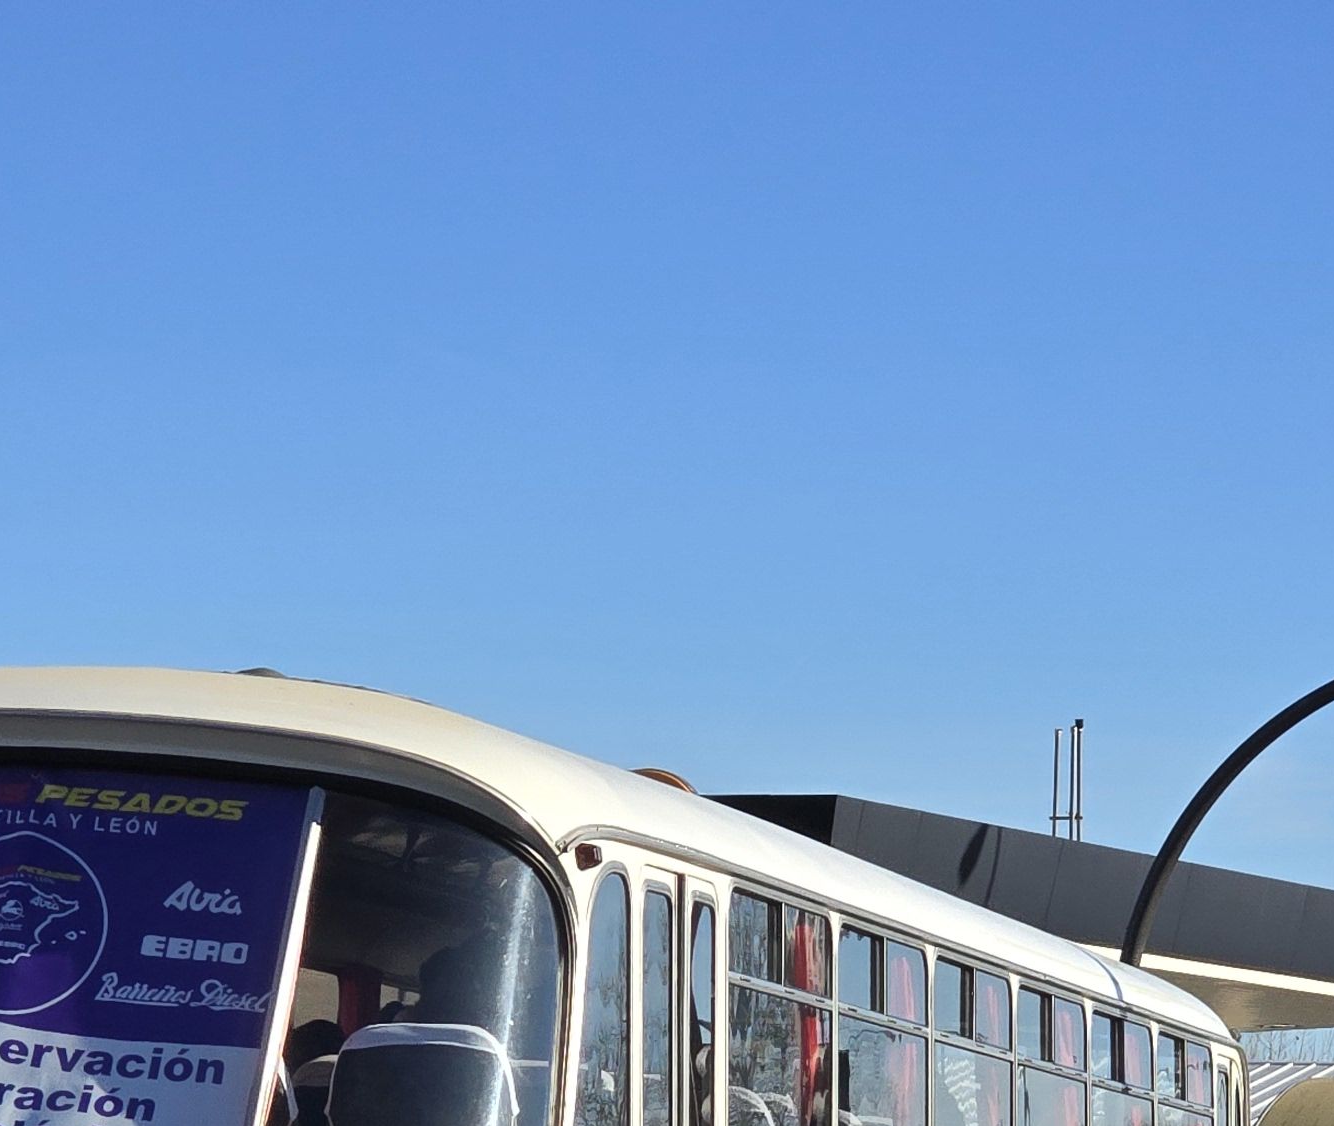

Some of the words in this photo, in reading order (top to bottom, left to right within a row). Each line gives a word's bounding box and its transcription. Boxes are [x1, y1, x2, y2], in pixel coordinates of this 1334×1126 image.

[35, 784, 250, 821] PESADOS
[69, 814, 84, 830] Y
[94, 816, 158, 836] LEÓN
[140, 935, 249, 964] EBRO
